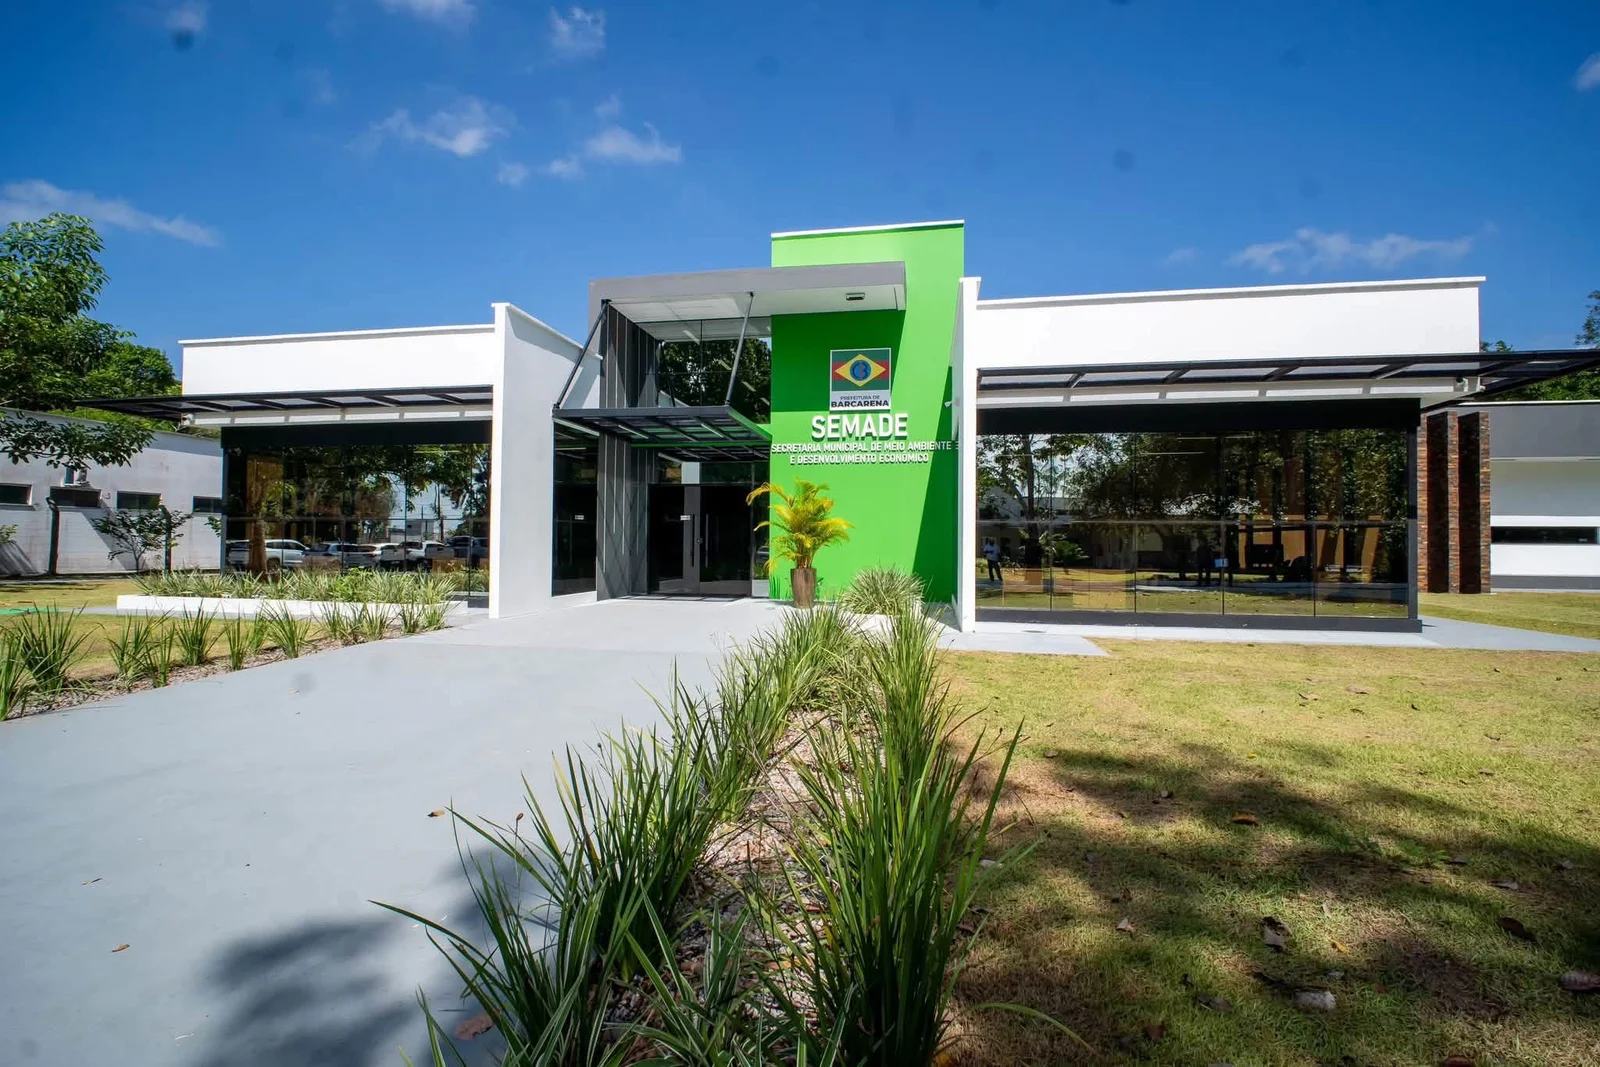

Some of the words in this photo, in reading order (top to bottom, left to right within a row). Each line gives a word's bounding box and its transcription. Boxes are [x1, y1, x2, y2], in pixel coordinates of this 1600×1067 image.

[812, 413, 908, 439] SEMADE
[771, 442, 822, 452] SECRETARIA
[823, 442, 868, 452] MUNICIPAL
[871, 442, 882, 452] DE
[884, 442, 905, 451] MEIO
[908, 441, 952, 450] AMBIENTE
[790, 455, 796, 464] E
[798, 454, 876, 464] DESENVOLVIMENTO
